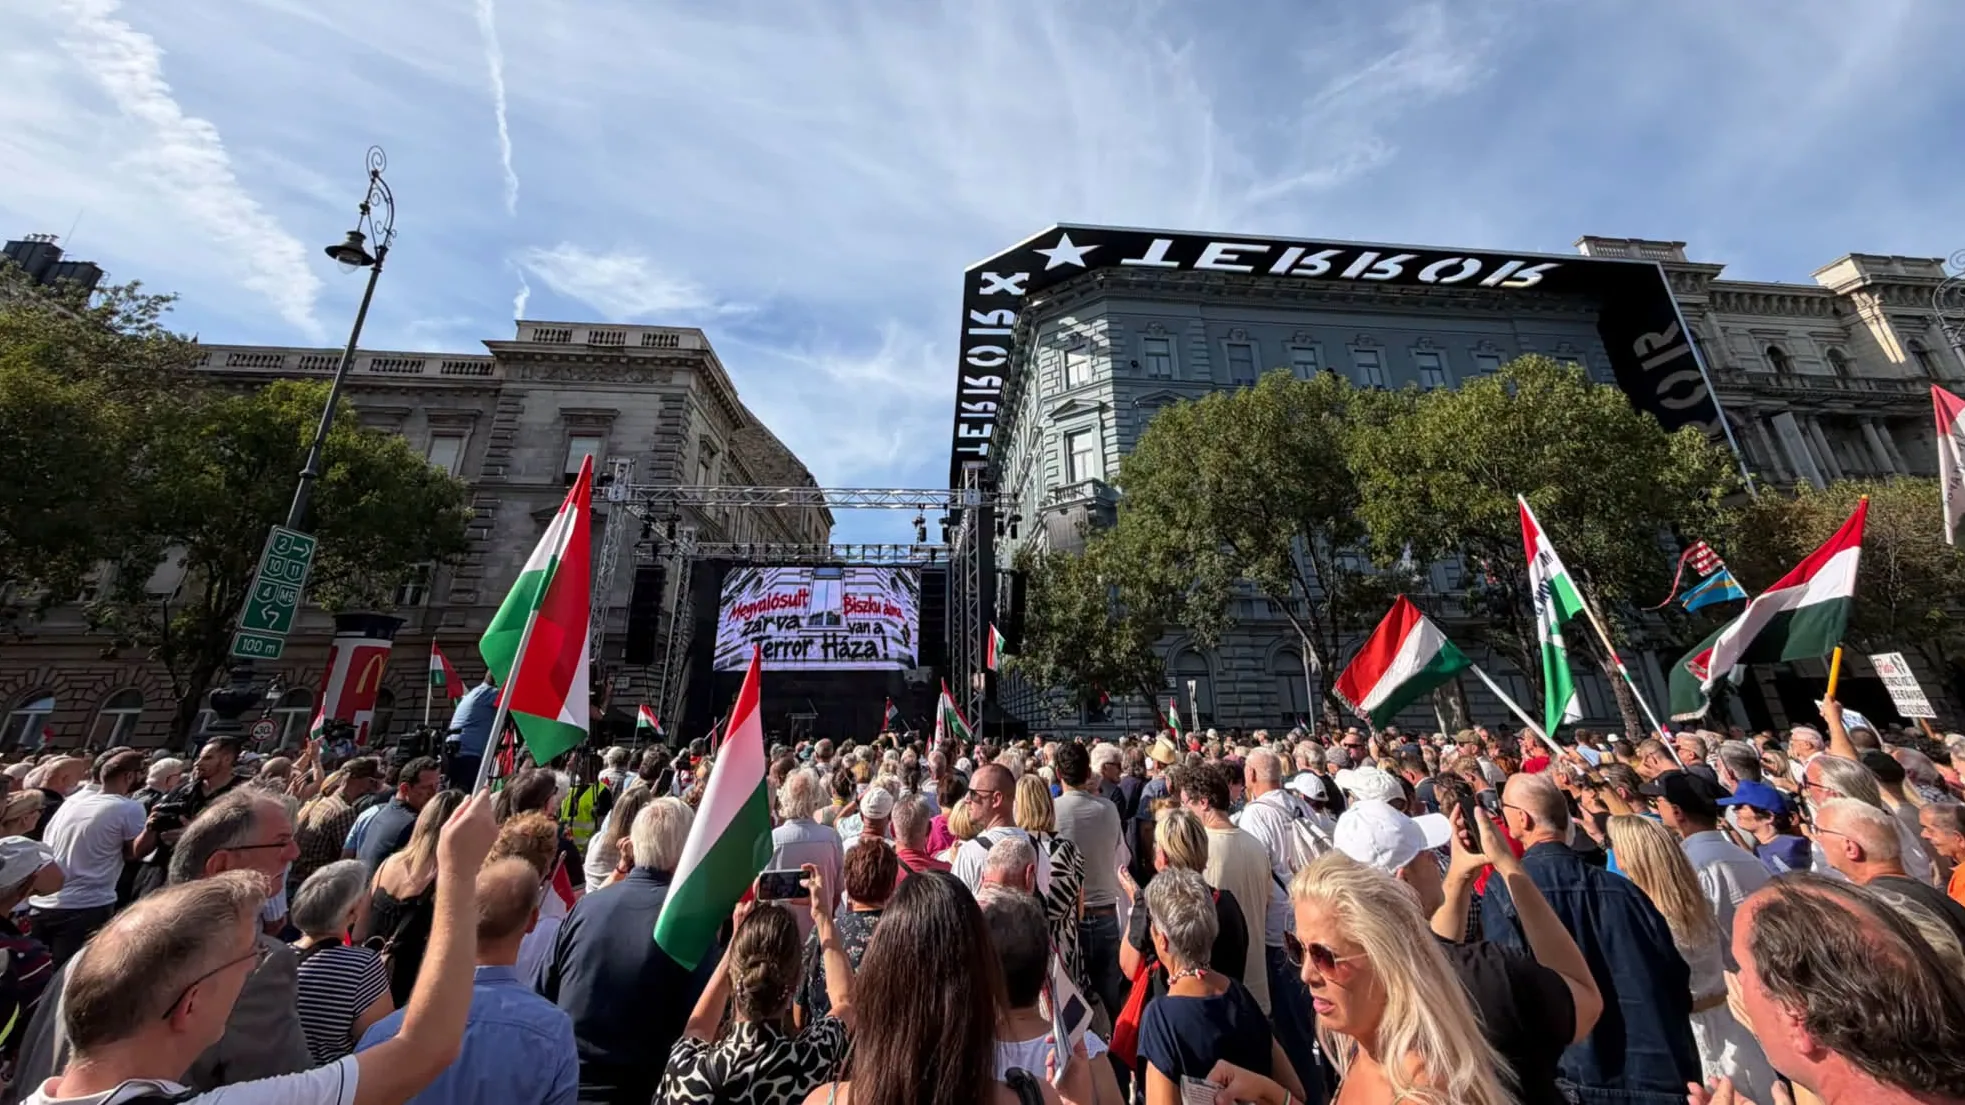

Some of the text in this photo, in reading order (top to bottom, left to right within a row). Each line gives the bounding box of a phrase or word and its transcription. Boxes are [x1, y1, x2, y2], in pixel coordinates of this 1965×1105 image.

[278, 539, 288, 550] 2
[269, 557, 300, 576] 10 11
[262, 586, 295, 603] 4 M5
[727, 588, 809, 621] Megvalósult
[843, 594, 881, 616] Biszku
[848, 622, 870, 634] van
[873, 622, 885, 634] a
[242, 638, 276, 654] 100 m
[821, 632, 889, 660] Háza!
